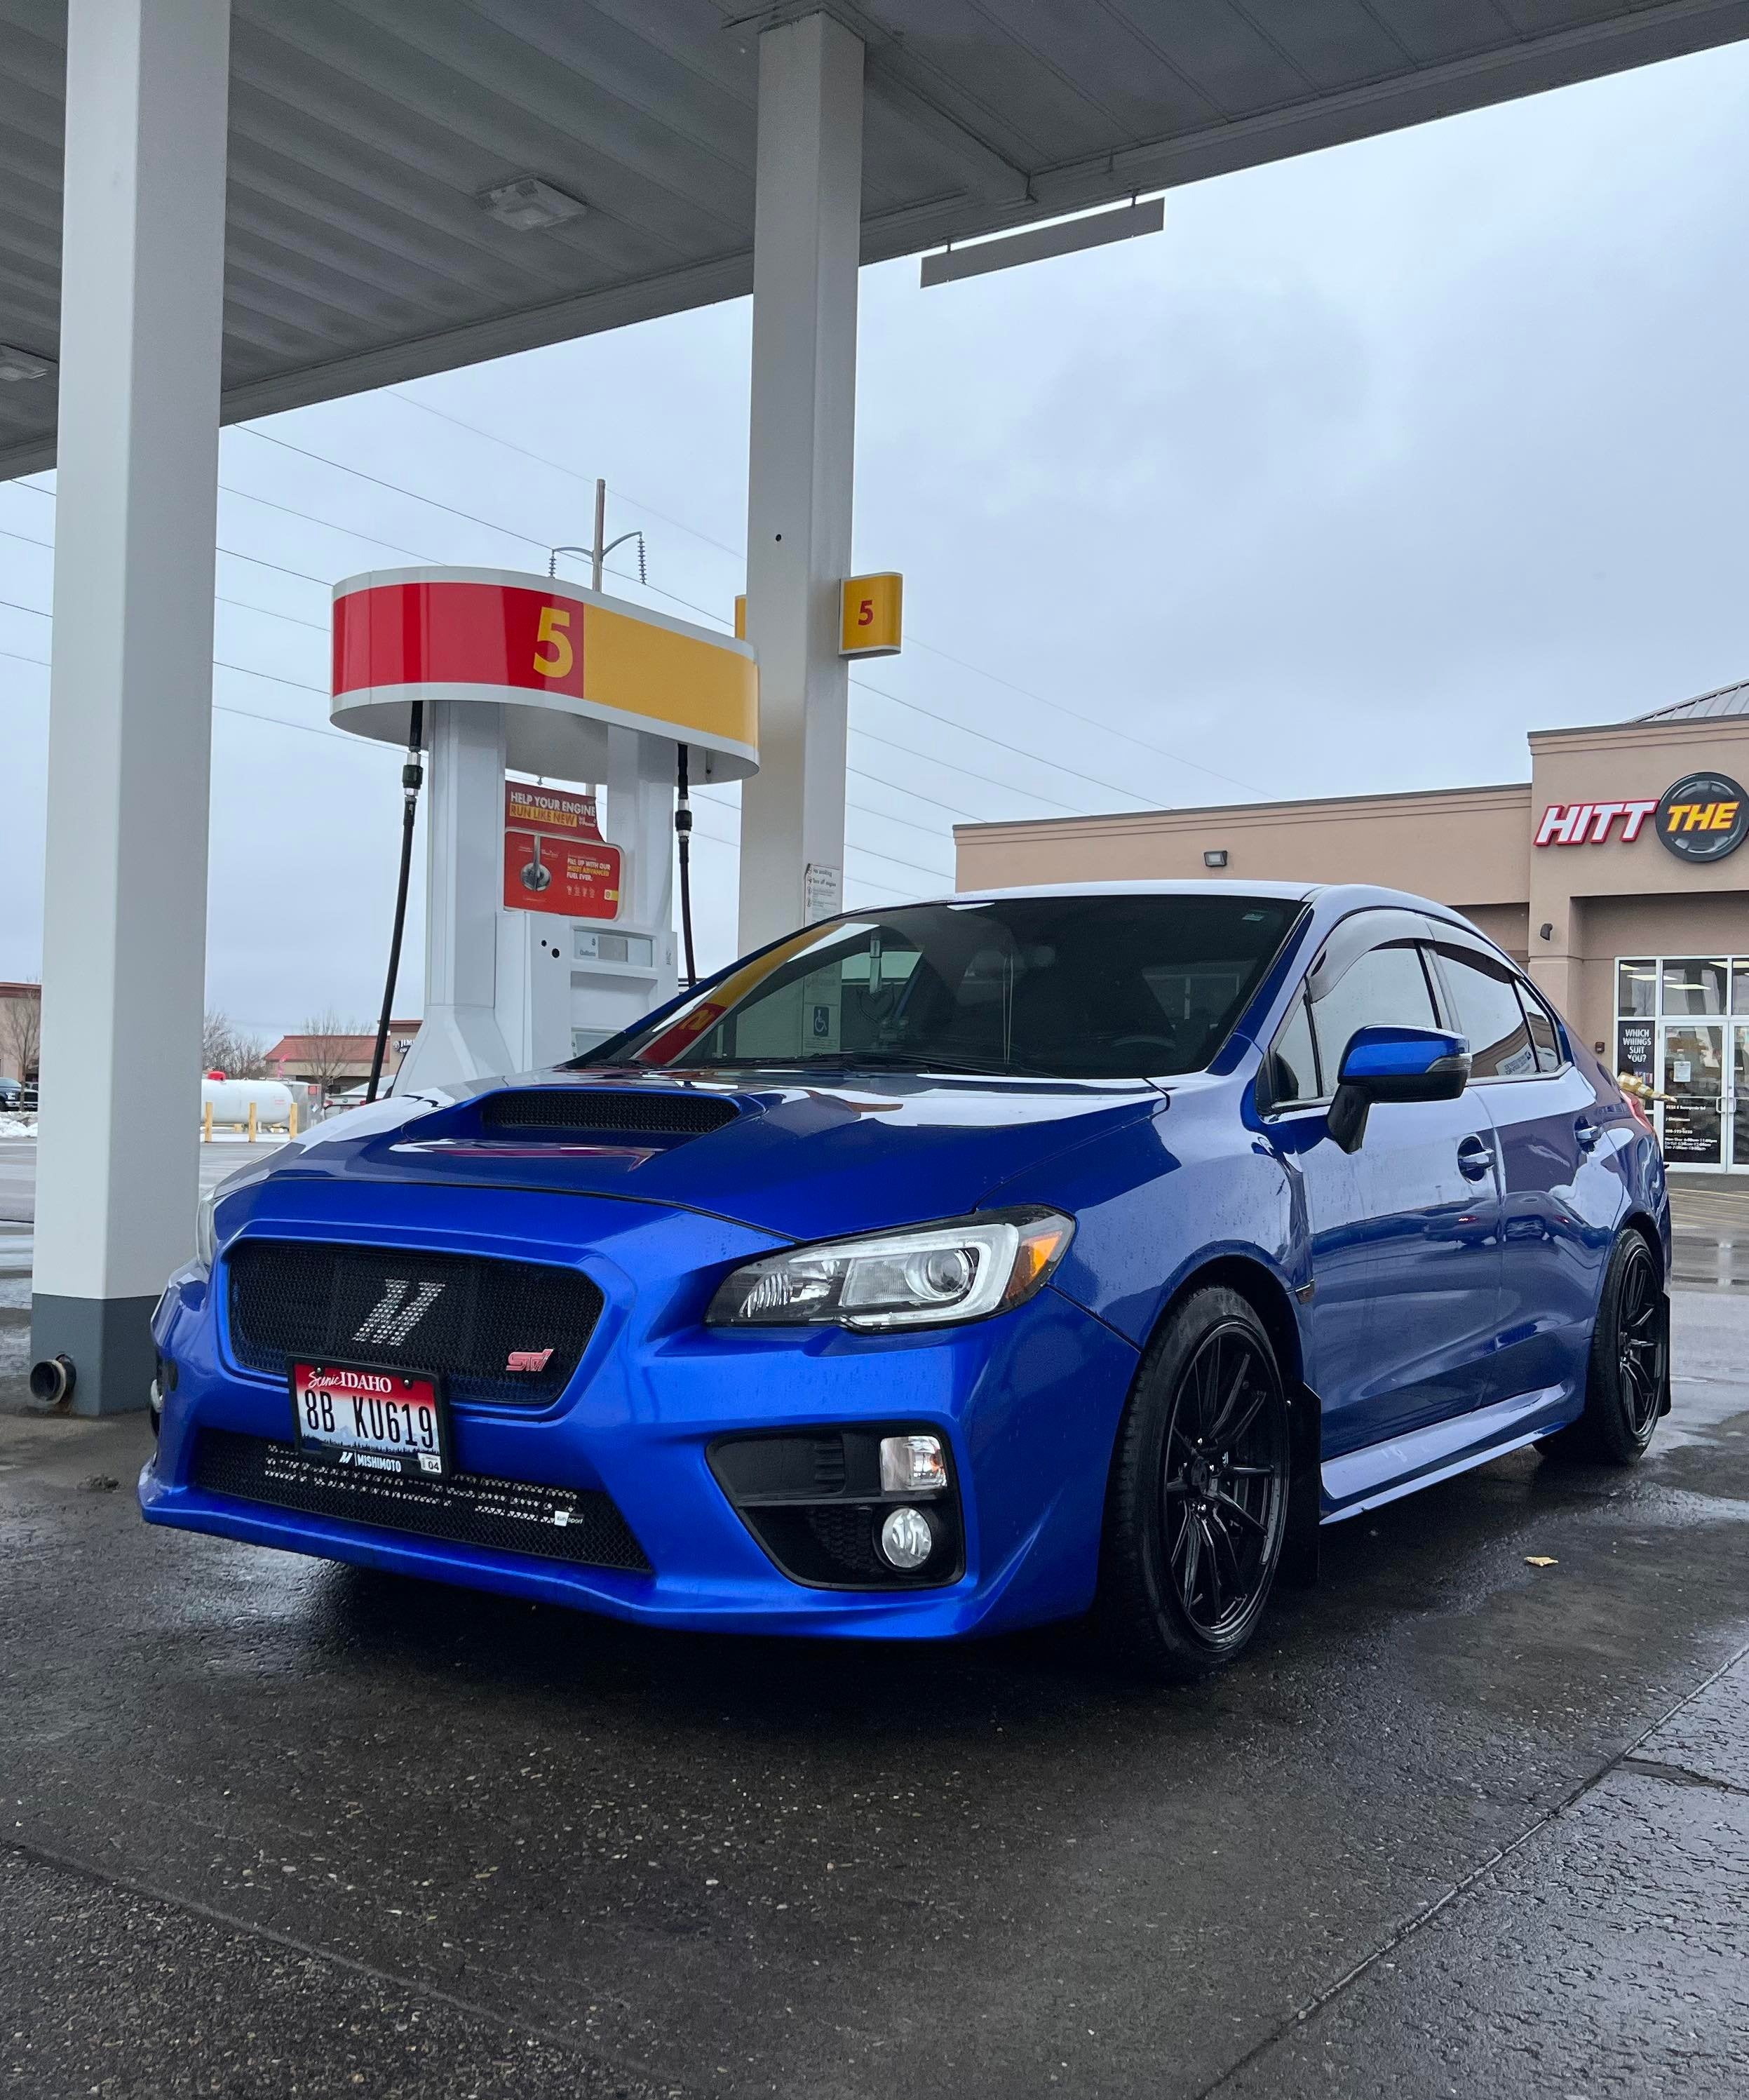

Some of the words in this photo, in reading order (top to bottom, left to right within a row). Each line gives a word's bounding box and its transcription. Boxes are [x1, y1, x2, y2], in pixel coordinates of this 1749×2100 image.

[858, 600, 874, 626] 5
[533, 607, 574, 678] 5
[511, 791, 532, 805] HELP
[534, 797, 560, 811] YOUR
[562, 801, 595, 816] ENGINE
[511, 805, 531, 818] RUN
[533, 807, 551, 821] LIKE
[554, 812, 575, 825] NEW
[1534, 800, 1661, 845] HITT
[1666, 801, 1740, 833] THE
[1625, 1029, 1649, 1037] WHICH
[1629, 1045, 1645, 1054] SUIT
[308, 1371, 342, 1389] Scenic
[339, 1371, 392, 1393] IDAHO
[304, 1389, 335, 1433] 8B
[352, 1395, 433, 1449] KU619
[357, 1453, 402, 1473] MISHIMOTO
[428, 1460, 440, 1471] 04
